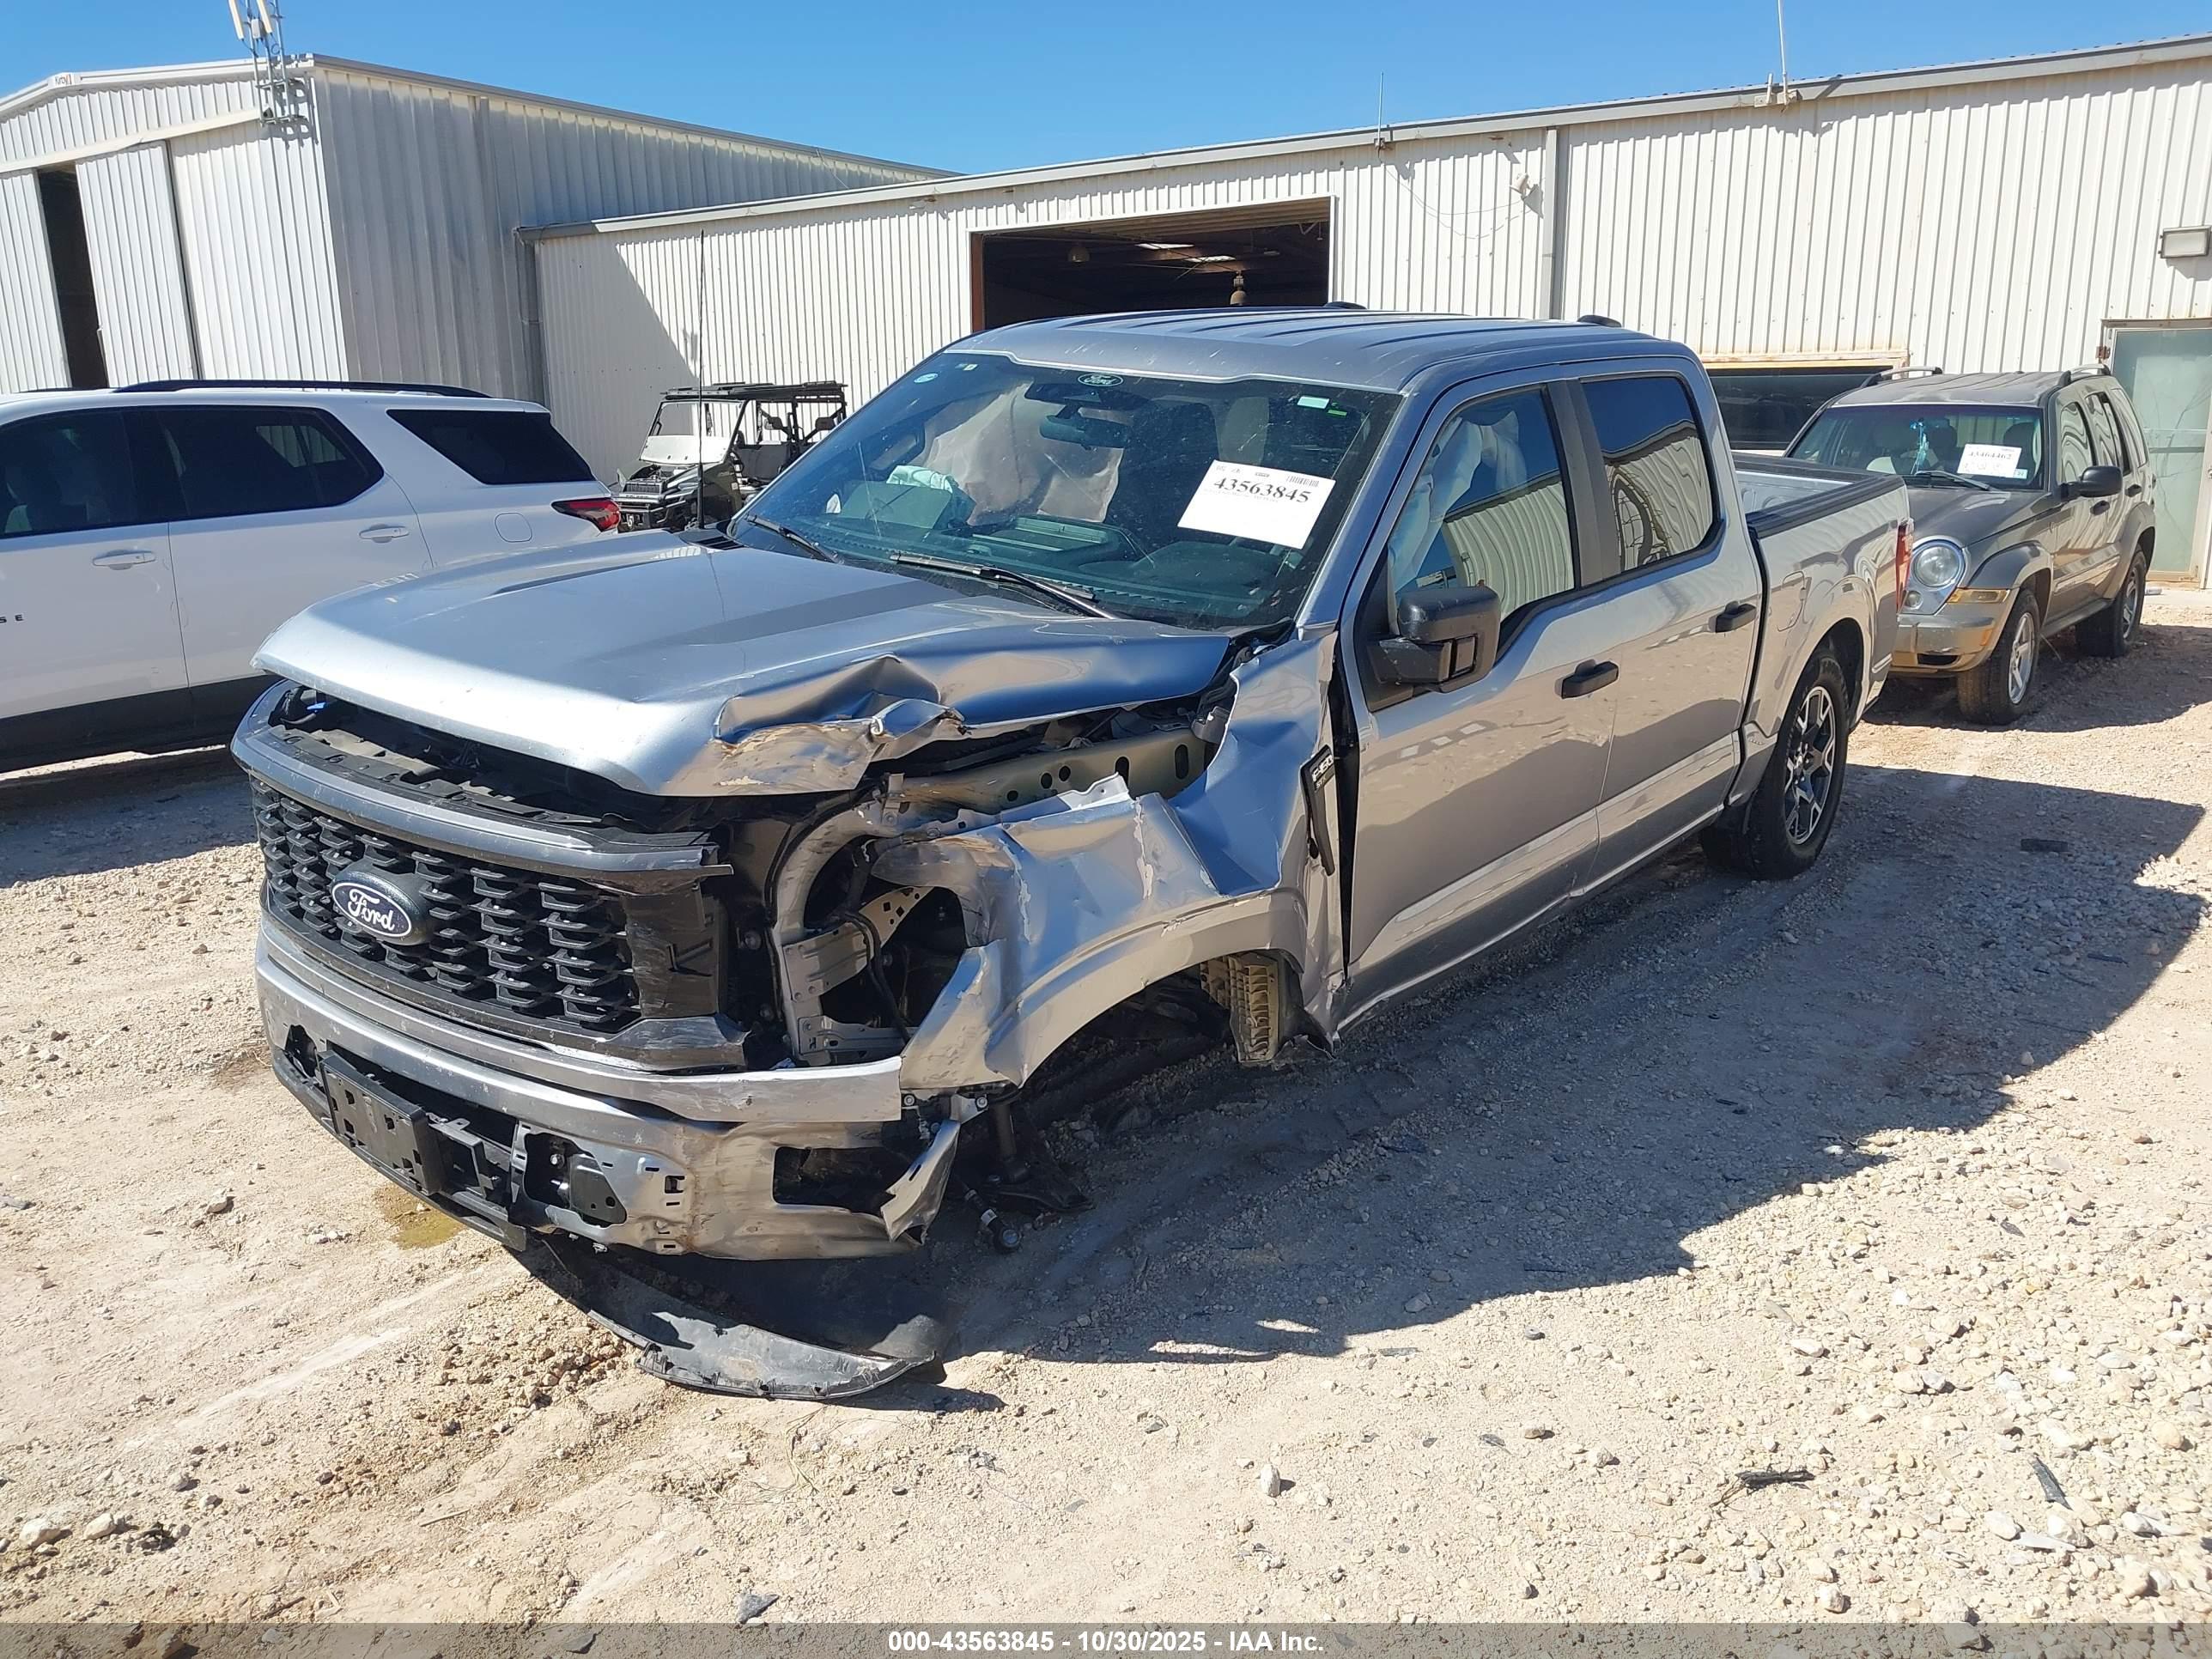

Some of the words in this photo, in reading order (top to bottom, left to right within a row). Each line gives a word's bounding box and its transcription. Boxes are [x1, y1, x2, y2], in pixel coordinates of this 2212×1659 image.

[1084, 374, 1117, 385] Ford
[1213, 477, 1312, 503] 43563845
[347, 888, 396, 931] Ford
